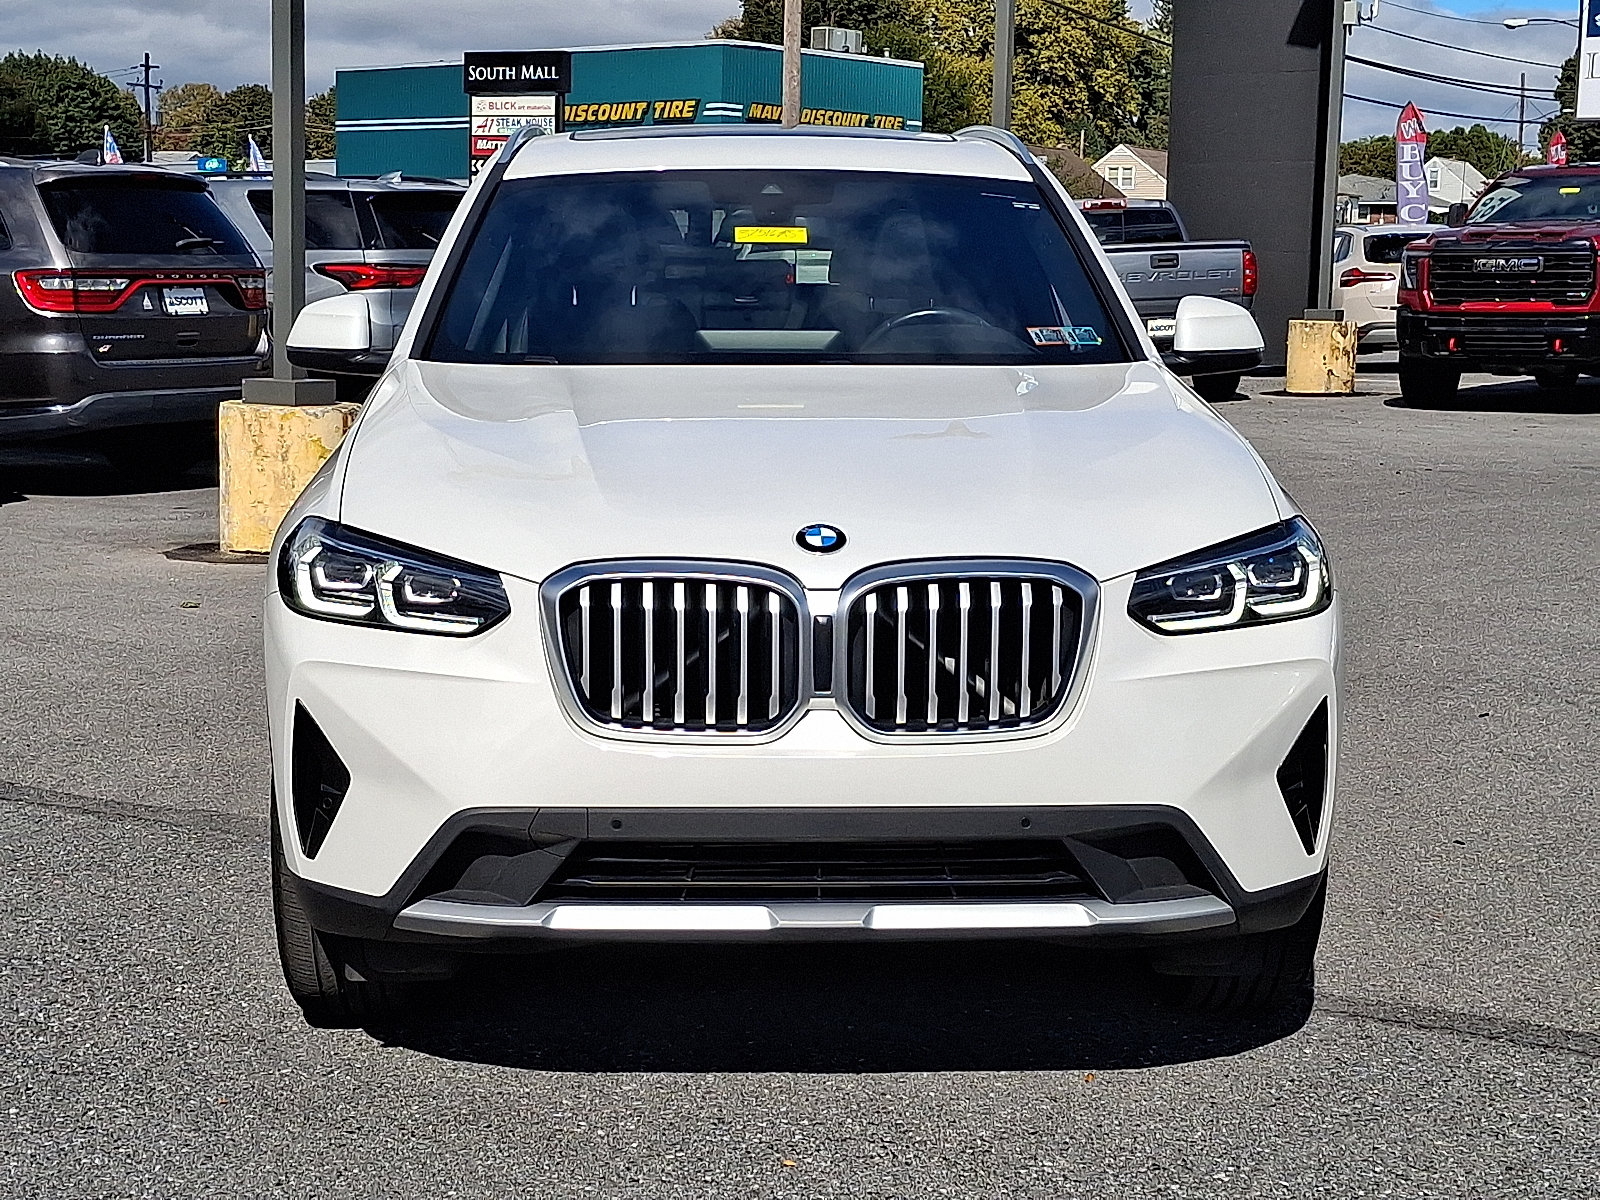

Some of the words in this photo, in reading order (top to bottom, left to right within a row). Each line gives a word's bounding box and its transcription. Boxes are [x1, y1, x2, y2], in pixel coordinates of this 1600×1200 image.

[468, 65, 516, 80] SOUTH
[521, 64, 559, 79] MALL
[488, 101, 517, 110] BLICK
[654, 100, 695, 119] TIRE
[495, 117, 523, 127] STEAK
[800, 108, 869, 128] DISCOUNT
[873, 115, 904, 130] TIRE
[1478, 258, 1539, 272] GMC
[174, 296, 205, 306] SCOTT
